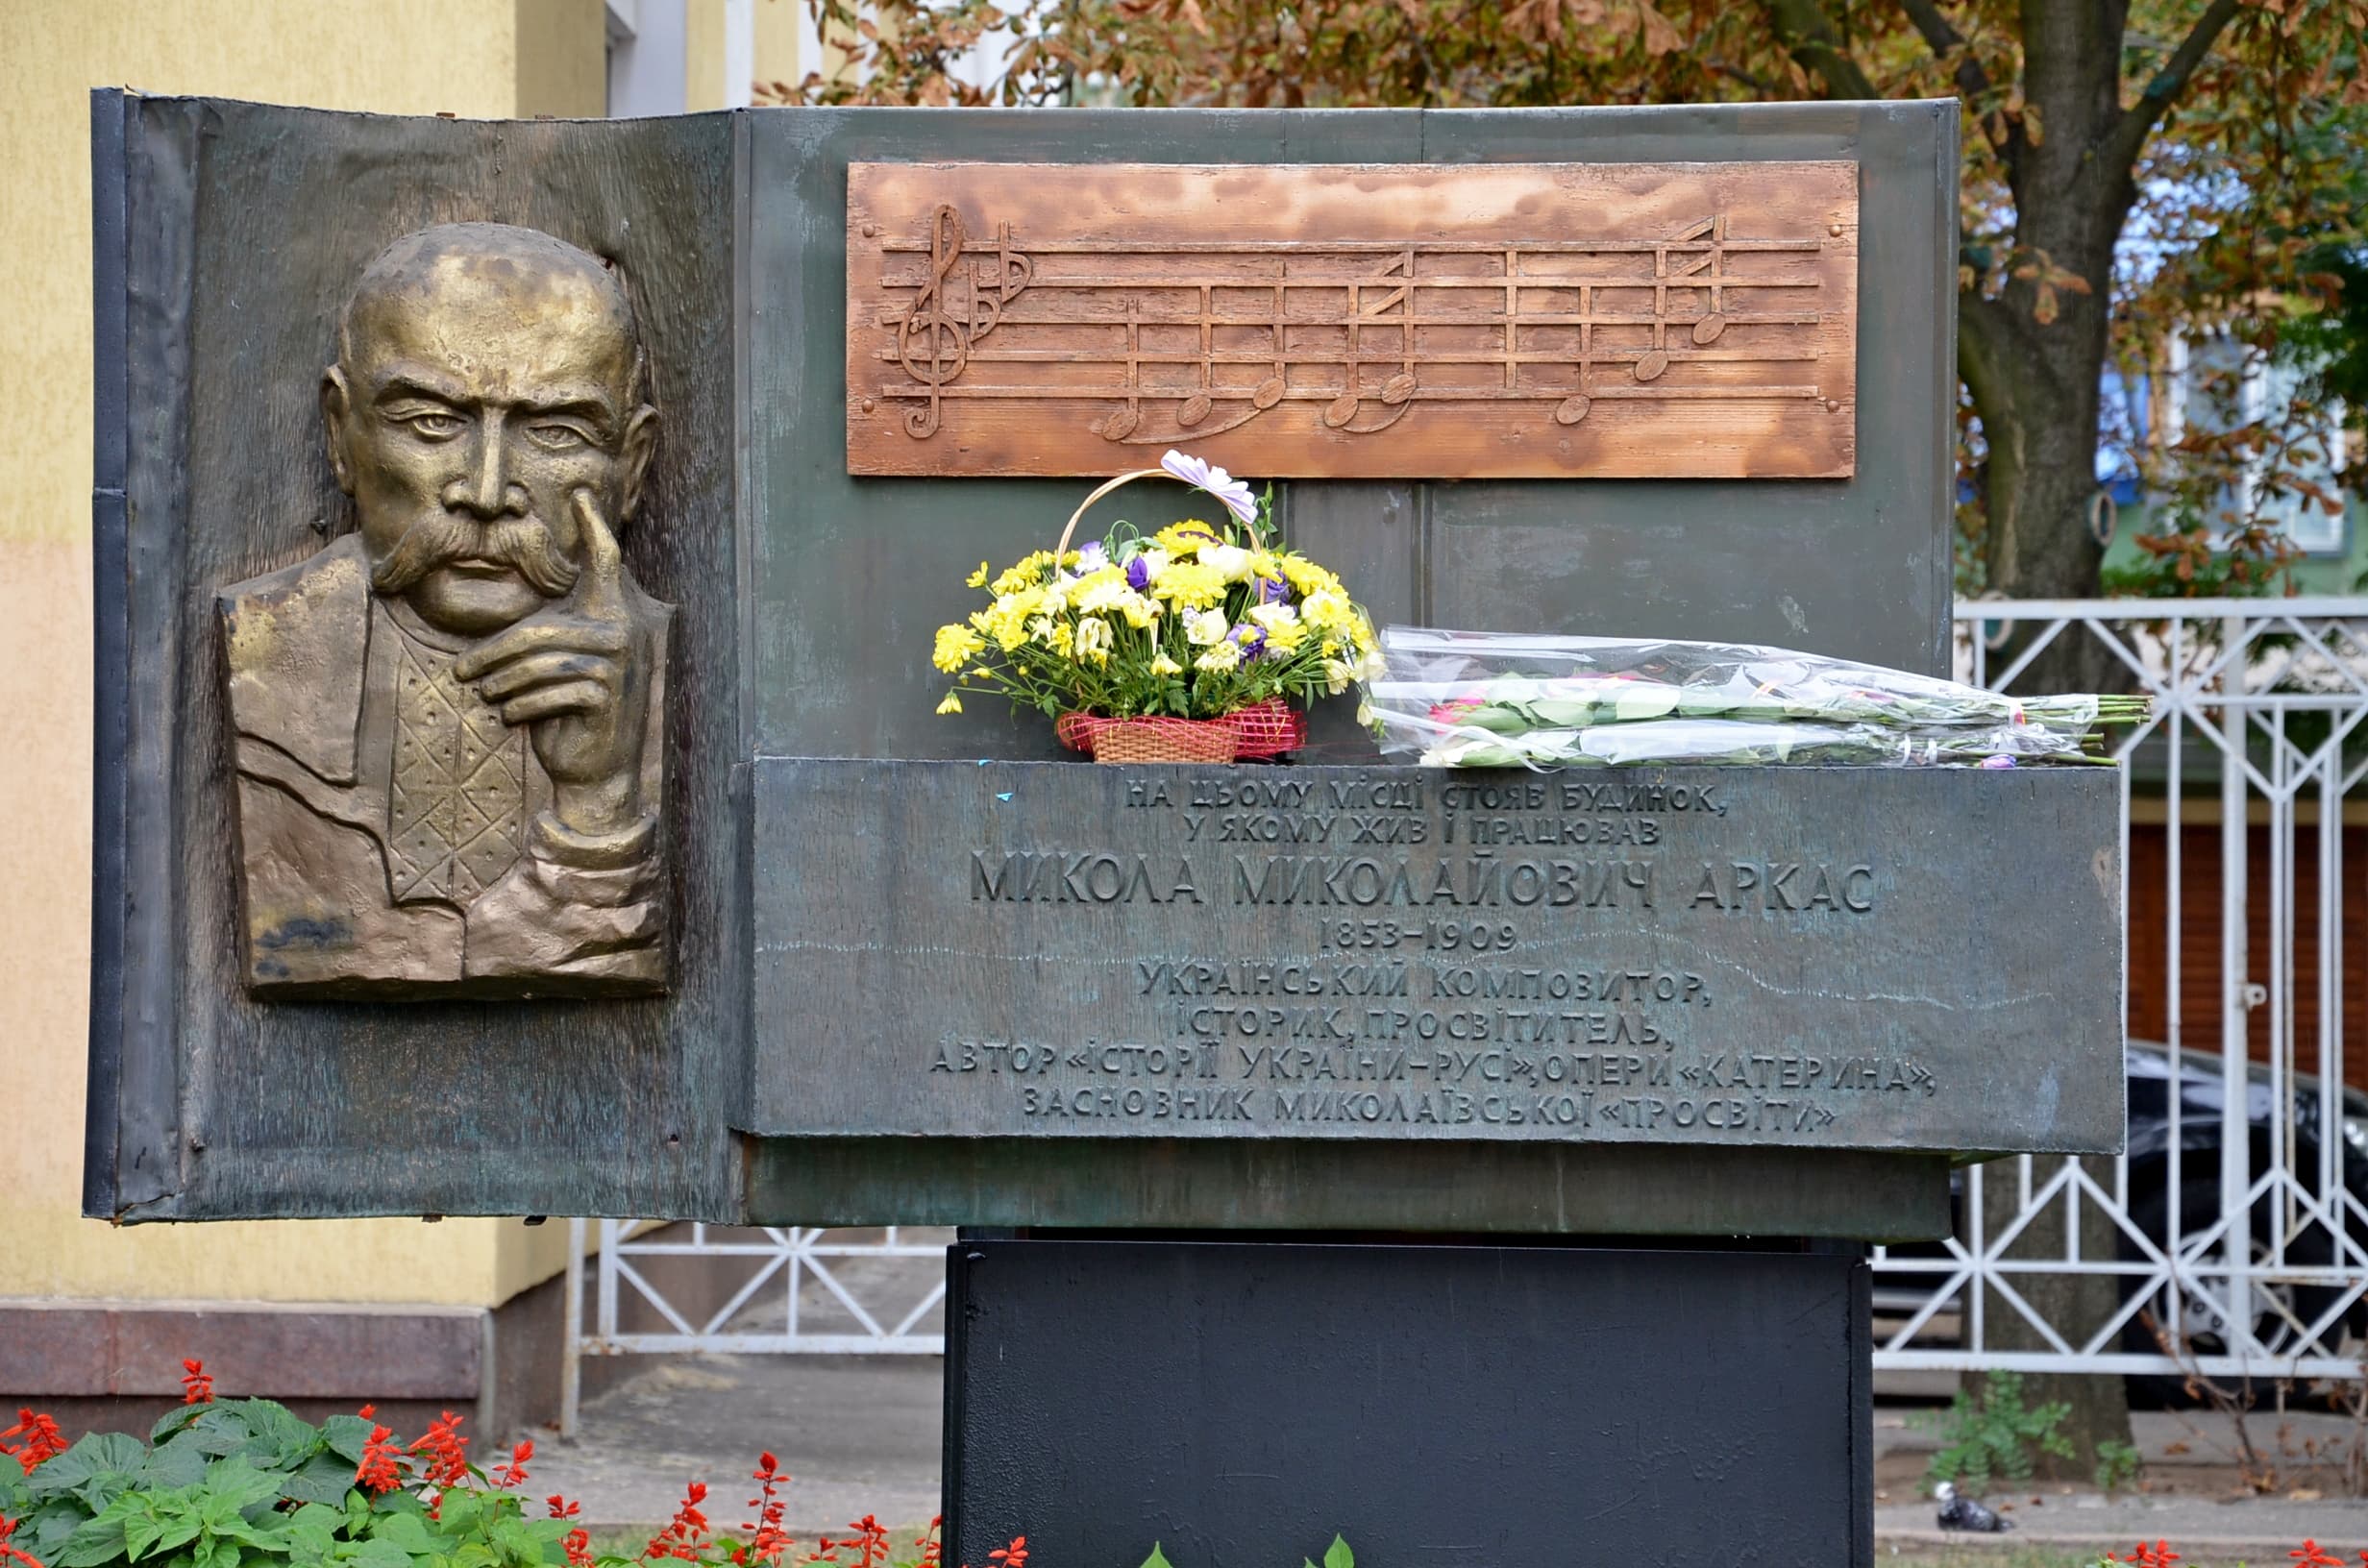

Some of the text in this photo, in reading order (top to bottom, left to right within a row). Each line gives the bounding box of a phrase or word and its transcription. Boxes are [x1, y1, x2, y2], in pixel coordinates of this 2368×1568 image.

[1125, 773, 1728, 817] НА ЦЬОМУ МІСЦІ СТОЯВ БУДИНОК,
[1183, 814, 1206, 843] У
[1218, 815, 1337, 844] ЯКОМУ
[1350, 816, 1429, 845] ЖИВ
[1469, 817, 1661, 845] ПРАЦЮВАВ
[971, 848, 1873, 913] МИКОЛА МИКОЛАЙОВИЧ АРКАС
[1138, 959, 1713, 1008] УКРАЇНСЬКИЙ КОМПОЗИТОР,
[1176, 999, 1674, 1052] ІСТОРИК, ПРОСВІТИТЕЛЬ,
[929, 1039, 1056, 1074] АВТОР
[1543, 1053, 1671, 1087] ОПЕРИ
[1023, 1086, 1838, 1133] ЗАСНОВНИК МИКОЛАЇВСЬКОЇ «ПРОСВІТИ»
